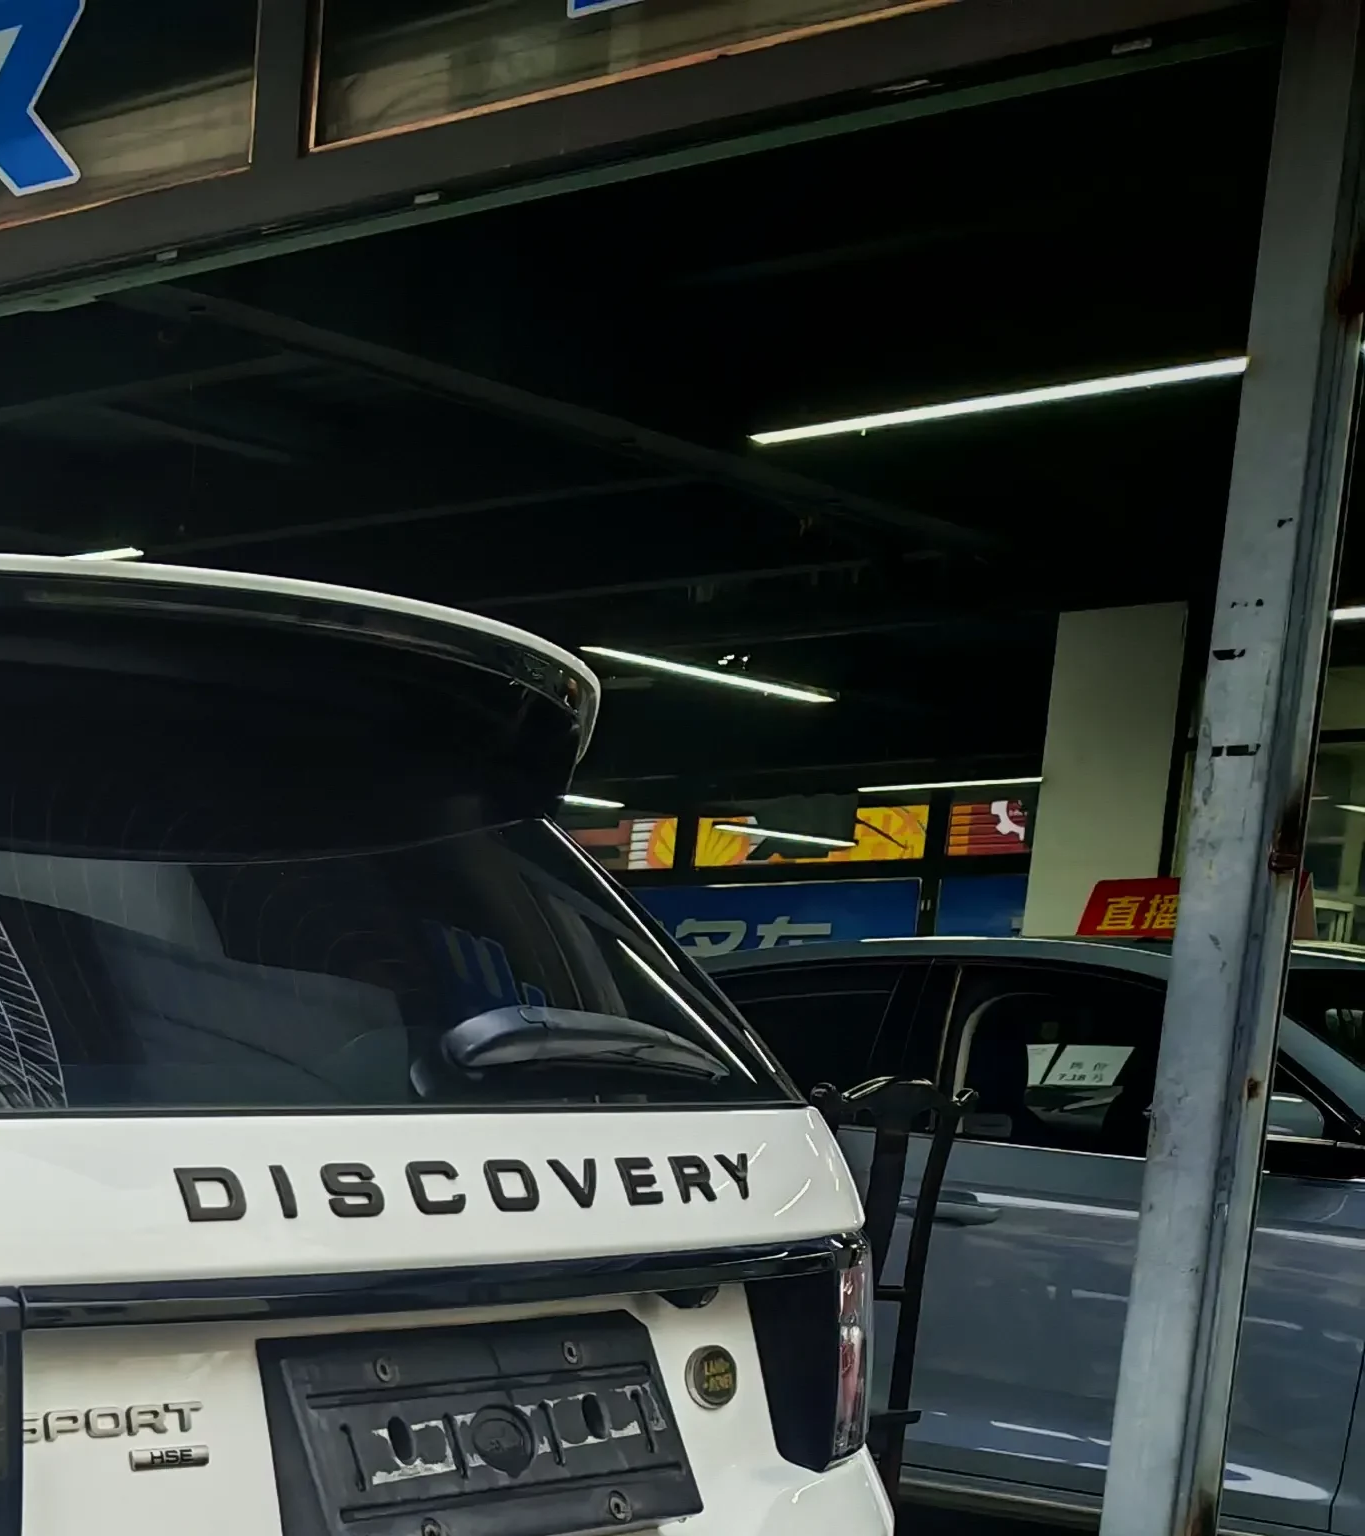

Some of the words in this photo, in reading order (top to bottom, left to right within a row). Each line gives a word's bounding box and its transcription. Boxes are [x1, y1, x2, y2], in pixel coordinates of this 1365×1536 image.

[173, 1152, 750, 1222] DISCOVERY
[22, 1400, 204, 1444] SPORT
[150, 1448, 194, 1466] HSE
